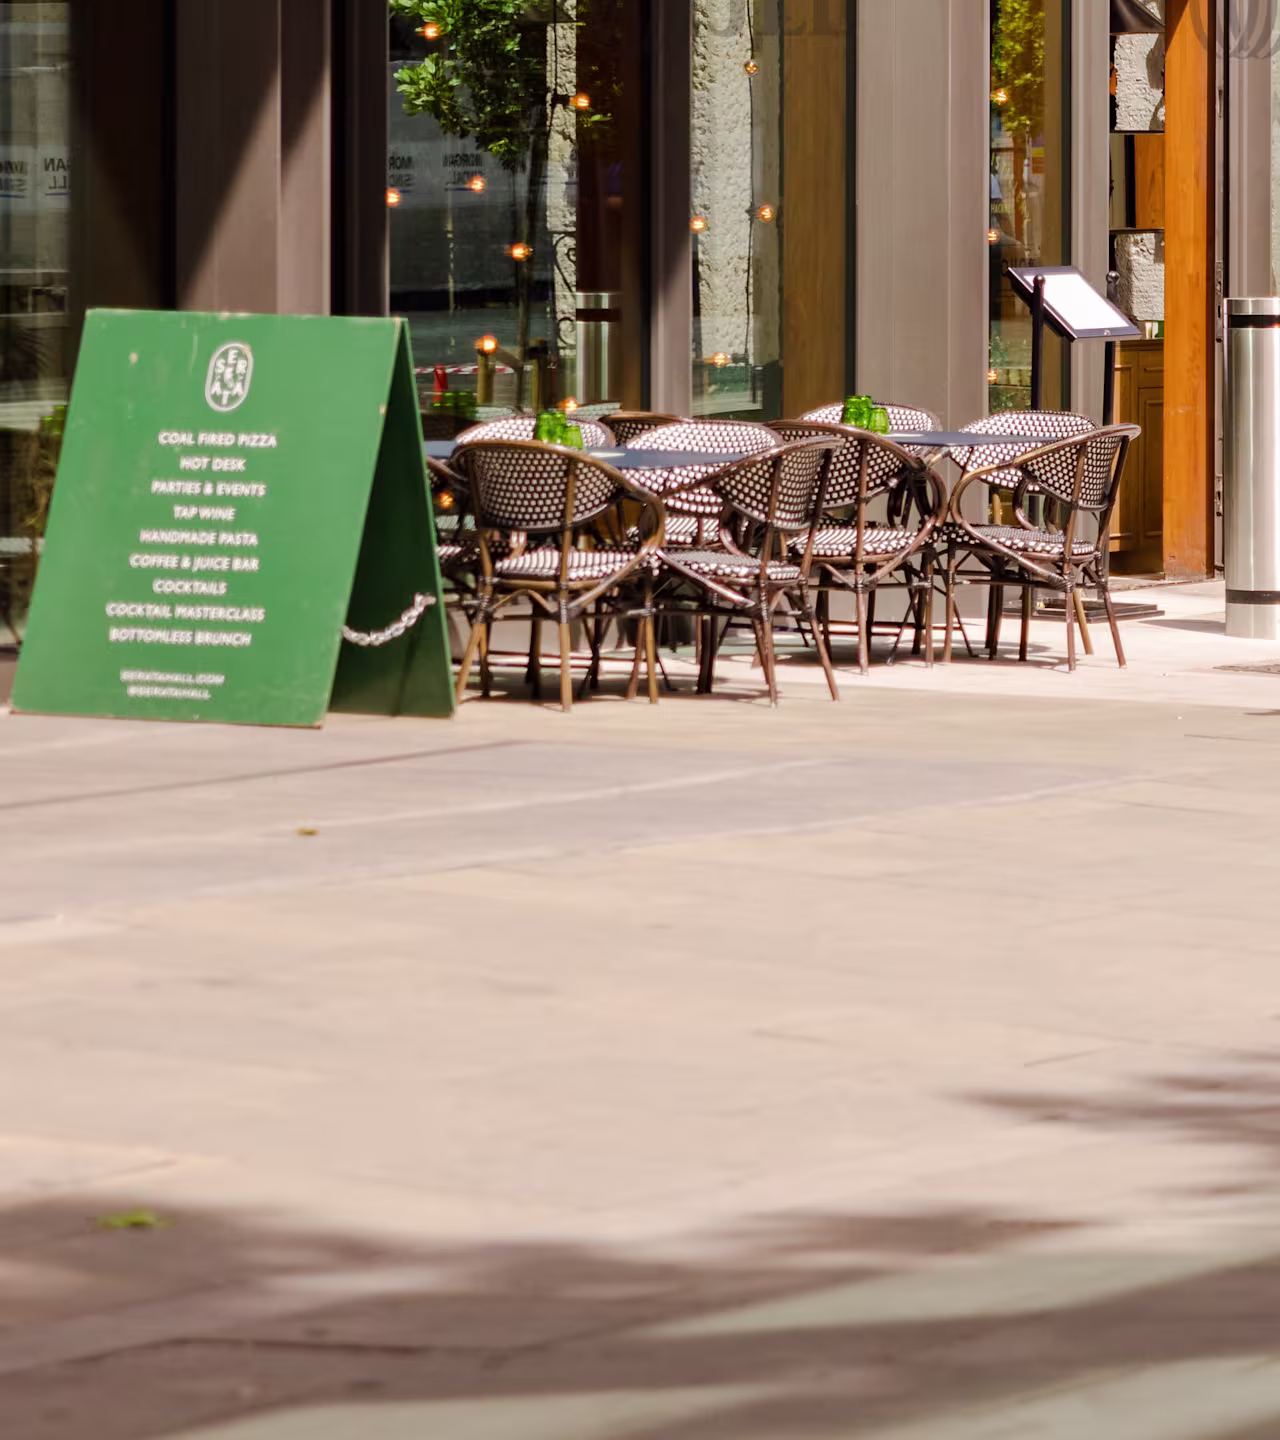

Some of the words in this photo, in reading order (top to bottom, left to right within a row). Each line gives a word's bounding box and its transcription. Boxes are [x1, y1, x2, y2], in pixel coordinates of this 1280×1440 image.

[158, 431, 195, 446] COAL
[198, 432, 235, 446] FIRED
[237, 433, 277, 448] PIZZA
[179, 456, 210, 471] HOT
[211, 457, 246, 472] DESK
[151, 480, 202, 494] PARTIES
[203, 482, 213, 496] &
[216, 482, 266, 497] EVENTS
[173, 505, 198, 519] TAP
[199, 507, 236, 521] WINE
[139, 529, 216, 545] HANDMADE
[218, 532, 258, 546] PASTA
[128, 553, 180, 569] COFFEE
[180, 556, 191, 569] &
[192, 556, 230, 572] JUICE
[231, 557, 260, 571] BAR
[152, 578, 227, 595] COCKTAILS
[105, 602, 172, 618] COCKTAIL
[174, 606, 265, 622] MASTERCLASS
[109, 627, 193, 644] BOTTOMLESS
[194, 631, 252, 647] BRUNCH
